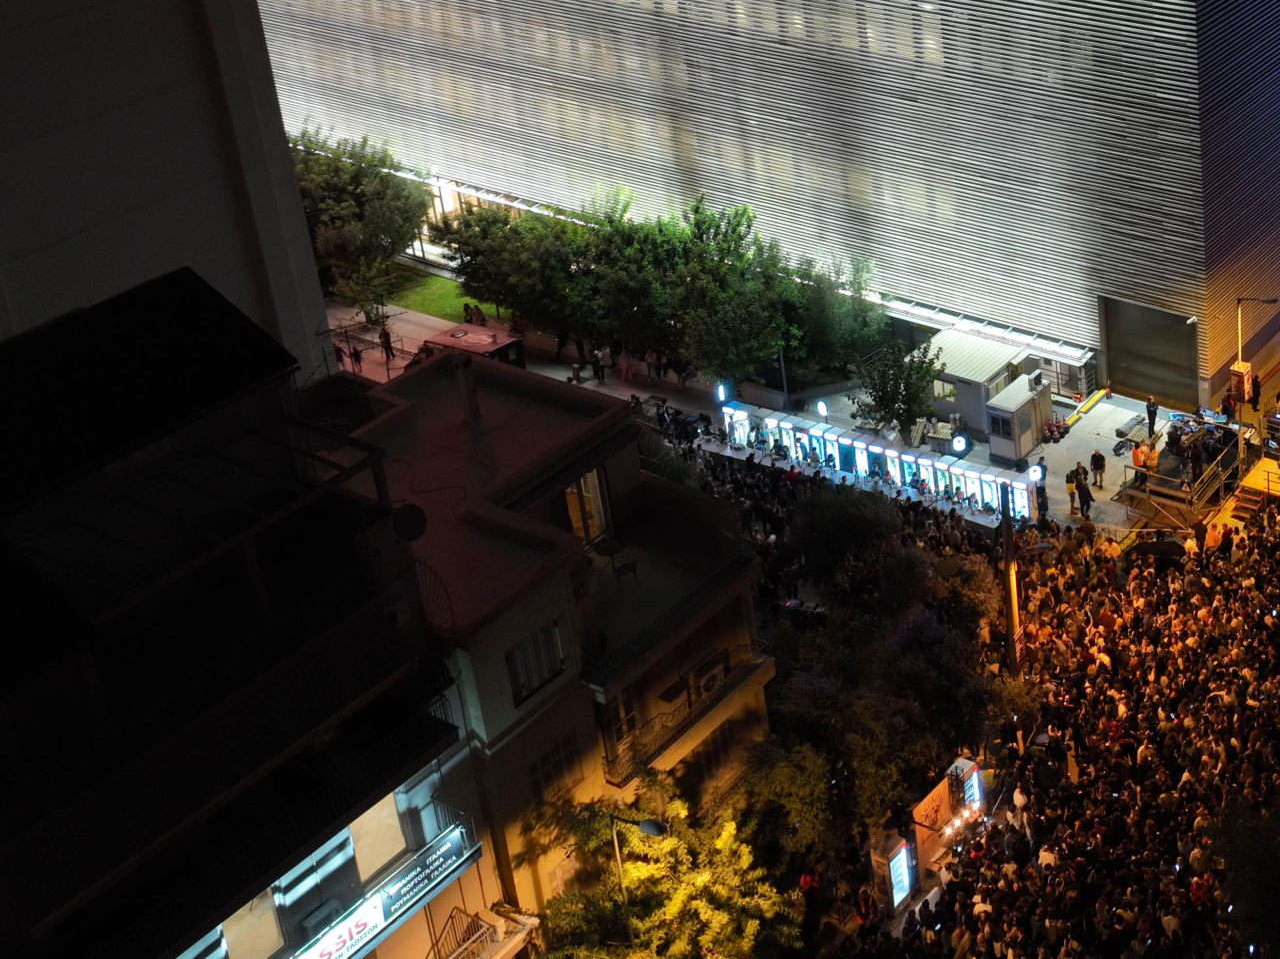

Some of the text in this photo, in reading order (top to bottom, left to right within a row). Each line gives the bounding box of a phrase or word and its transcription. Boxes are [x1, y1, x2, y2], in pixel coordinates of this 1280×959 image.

[388, 841, 452, 896] ΠΑΝΙΚΑ ΙΤΑΛΙΚΑ
[390, 855, 457, 912] ΡΟΥΜΑΝΙΚΑ ΓΑΛΛΙΚΑ
[401, 856, 445, 895] ΠΟΡΤΟΓΑΛΙΚΑ
[346, 923, 379, 952] ΓΛΩΣΣΩΝ
